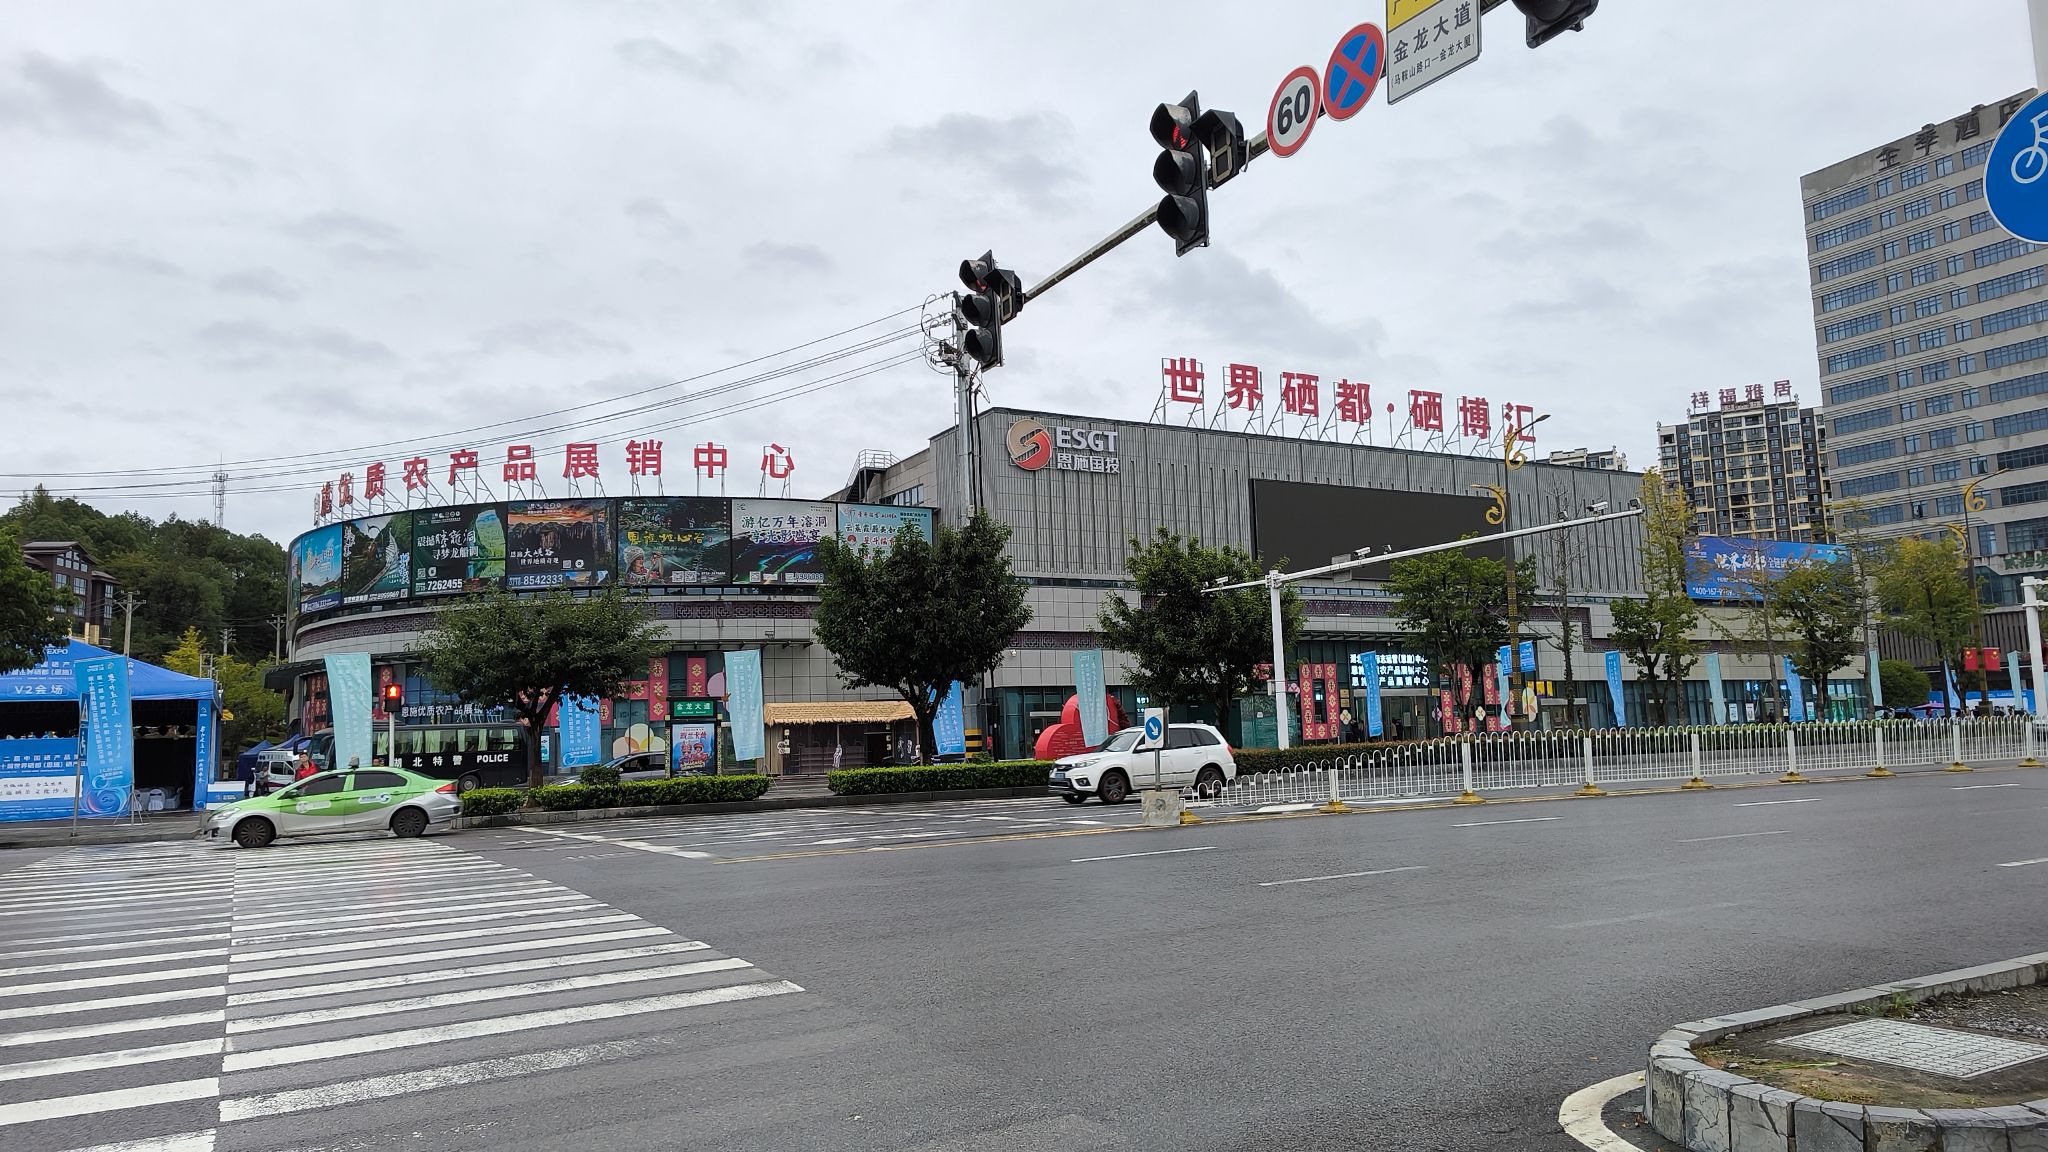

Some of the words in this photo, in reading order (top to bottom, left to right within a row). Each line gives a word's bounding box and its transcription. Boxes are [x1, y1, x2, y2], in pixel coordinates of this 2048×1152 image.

[1393, 1, 1472, 65] 金龙大道
[1277, 84, 1311, 135] 60
[1690, 379, 1792, 408] 祥福雅居
[1056, 426, 1118, 453] ESGT
[1057, 452, 1121, 475] 恩施国投
[313, 439, 796, 525] 优质农产品展销中心
[741, 515, 828, 529] 游亿万年溶洞
[751, 529, 820, 544] 享光影盛宴
[510, 547, 554, 558] 恩施大峡谷
[1352, 677, 1430, 687] 恩施产品展销中心
[676, 702, 711, 710] 金龙大道
[477, 753, 509, 763] POLICE
